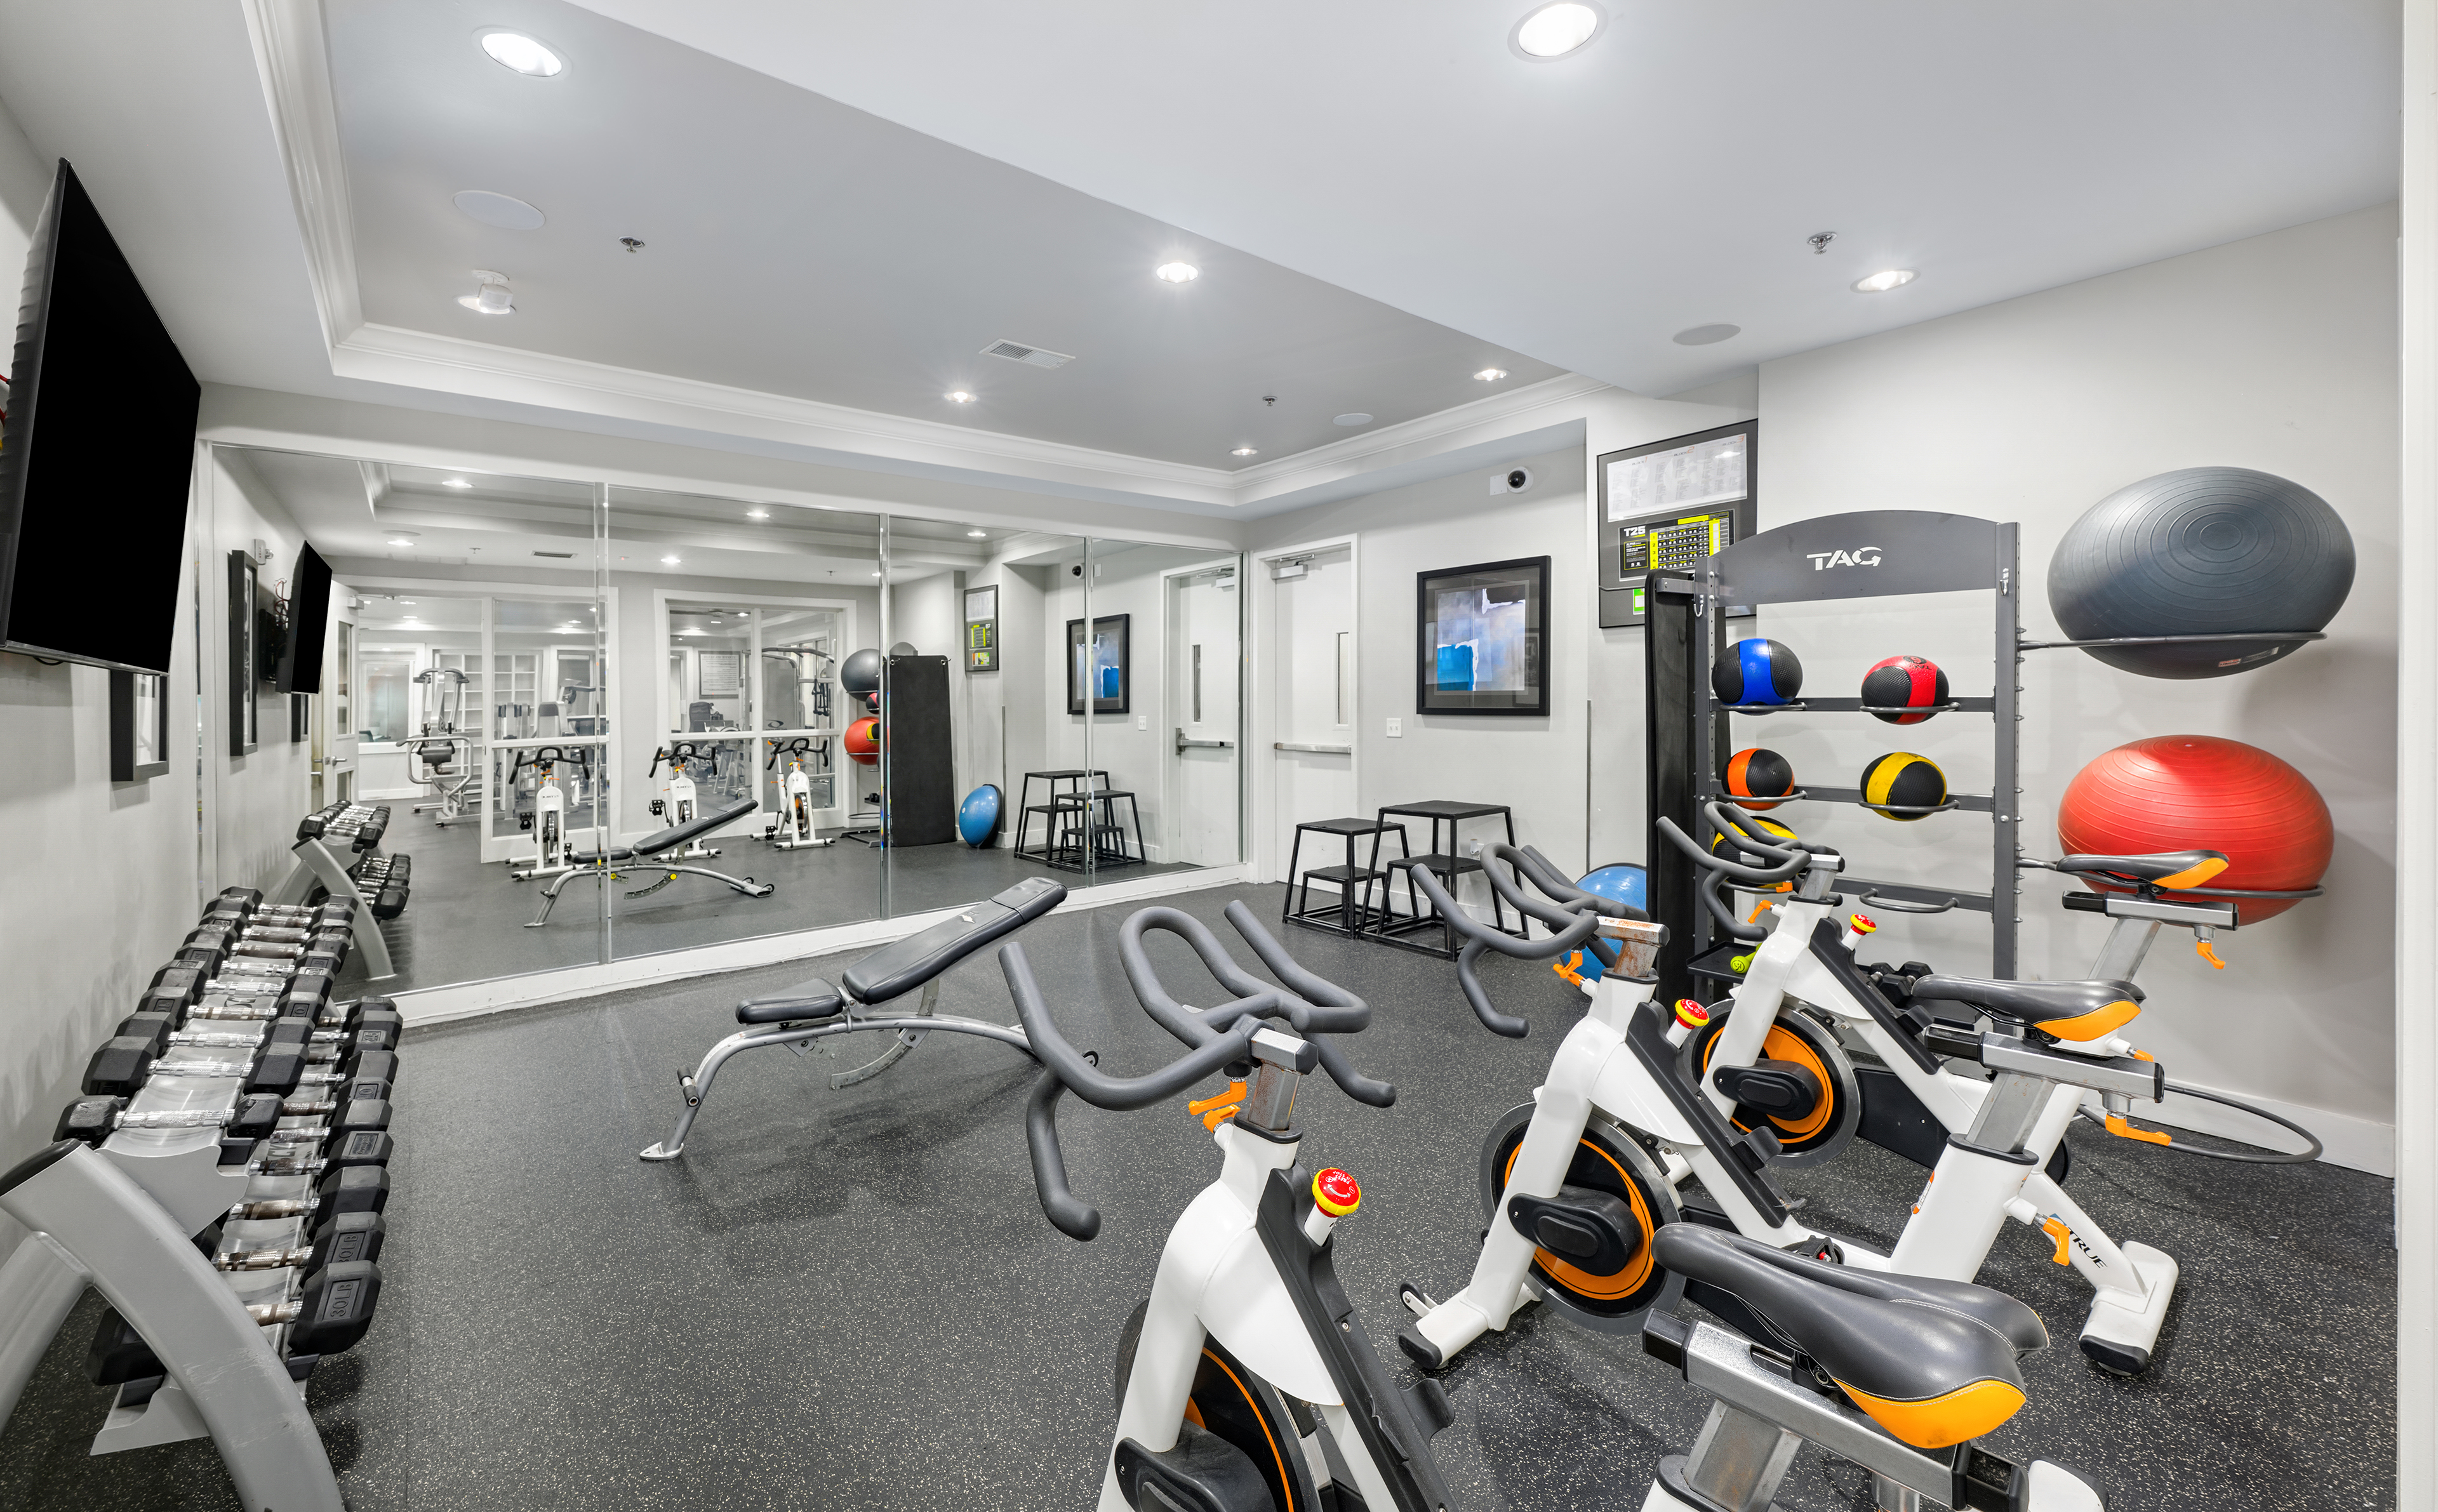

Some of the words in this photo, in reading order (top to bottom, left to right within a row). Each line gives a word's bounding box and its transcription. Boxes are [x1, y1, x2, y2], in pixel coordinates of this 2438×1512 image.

[1623, 526, 1646, 537] T25
[1806, 547, 1882, 571] TAG
[1335, 1174, 1350, 1184] PRESS
[2068, 1226, 2108, 1269] TRUE
[330, 1282, 354, 1317] 30LB
